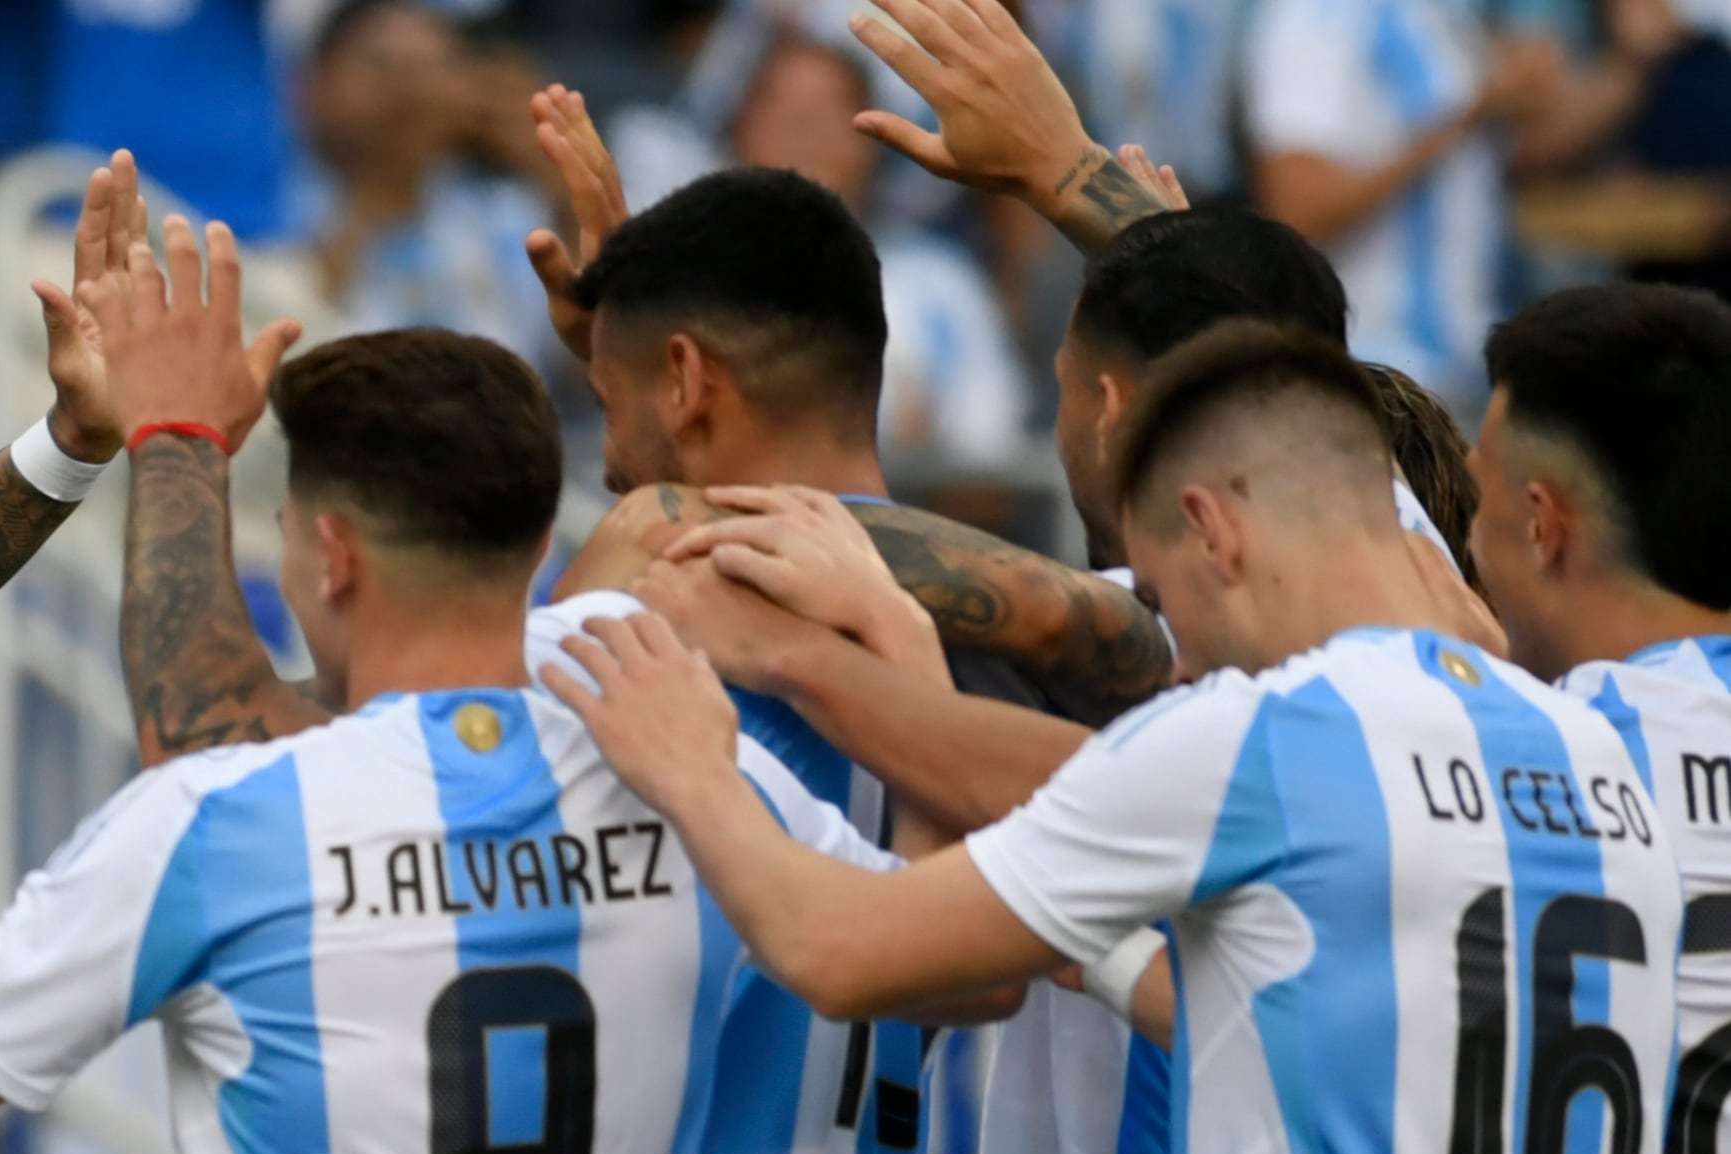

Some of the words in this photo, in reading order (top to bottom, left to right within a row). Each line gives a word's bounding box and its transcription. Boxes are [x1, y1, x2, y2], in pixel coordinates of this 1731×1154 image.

[1412, 753, 1484, 824] LO
[1502, 767, 1652, 847] CELSO
[327, 823, 673, 918] J.ALVAREZ
